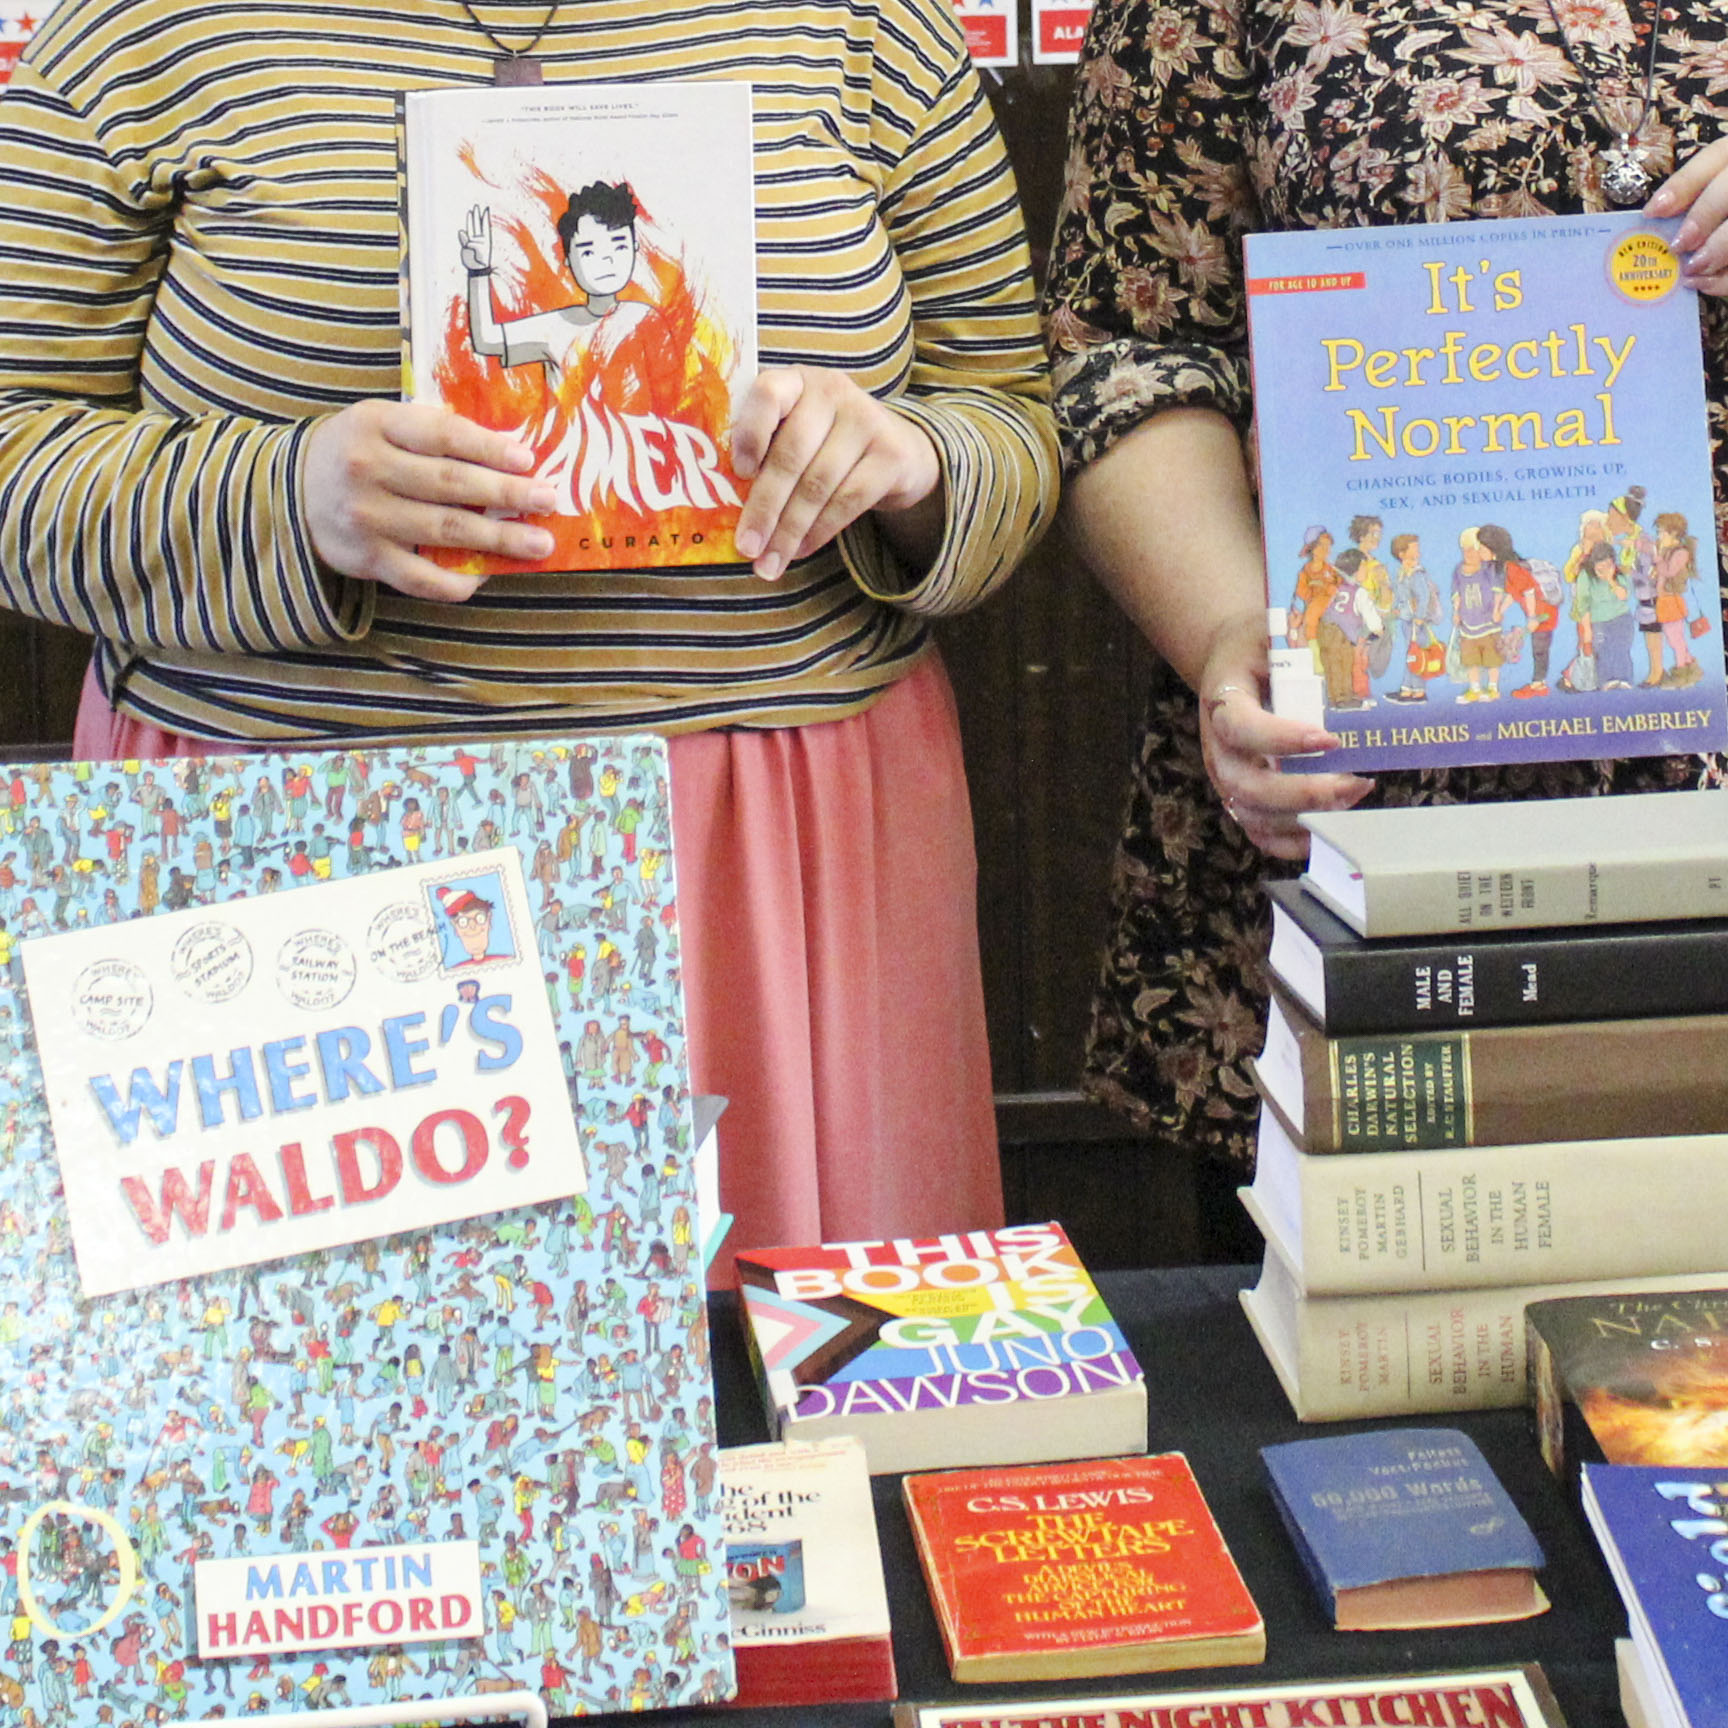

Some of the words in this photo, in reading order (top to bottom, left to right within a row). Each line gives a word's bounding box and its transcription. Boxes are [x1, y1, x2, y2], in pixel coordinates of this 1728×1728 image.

[1422, 259, 1524, 315] It's
[1321, 323, 1637, 391] Perfectly
[1344, 392, 1622, 461] Normal
[1379, 496, 1416, 511] SEX,
[1421, 494, 1457, 506] AND
[1462, 490, 1526, 505] SEXUAL
[1530, 485, 1597, 500] HEALTH
[579, 533, 704, 550] CURATO
[1366, 730, 1388, 746] H.
[1391, 725, 1470, 745] HARRIS
[1498, 718, 1597, 740] MICHAEL
[1603, 710, 1712, 734] EMBERLEY
[78, 993, 113, 1007] CAMP
[116, 993, 144, 1007] SITE
[1416, 966, 1431, 1010] MALE
[1438, 970, 1452, 1004] AND
[1458, 954, 1473, 1016] FEMALE
[1522, 964, 1538, 1002] Mead
[88, 993, 526, 1146] WHERE'S
[1382, 1051, 1398, 1136] NATURAL
[1401, 1044, 1418, 1144] SELECTION
[1345, 1054, 1360, 1136] CHARLES
[120, 1095, 533, 1246] WALDO?
[1439, 1188, 1456, 1252] SEXUAL
[1463, 1174, 1480, 1263] BEHAVIOR
[1489, 1190, 1503, 1223] THE
[1512, 1182, 1529, 1251] HUMAN
[1536, 1181, 1552, 1249] FEMALE
[821, 1225, 1061, 1268] THIS
[1491, 1227, 1504, 1244] IN
[773, 1245, 1078, 1302] BOOK
[985, 1273, 1088, 1312] IS
[878, 1295, 1099, 1348] GAY
[1651, 1339, 1679, 1351] C.
[1694, 1335, 1720, 1348] S.
[927, 1325, 1115, 1377] JUNO
[790, 1353, 1134, 1423] DAWSON
[1026, 1512, 1112, 1531] THE
[1036, 1487, 1154, 1511] LEWIS
[954, 1519, 1195, 1553] SCREWTAPE
[993, 1536, 1172, 1564] LETTERS
[245, 1553, 433, 1601] MARTIN
[207, 1594, 472, 1648] HANDFORD
[1282, 1683, 1523, 1728] KITCHEN
